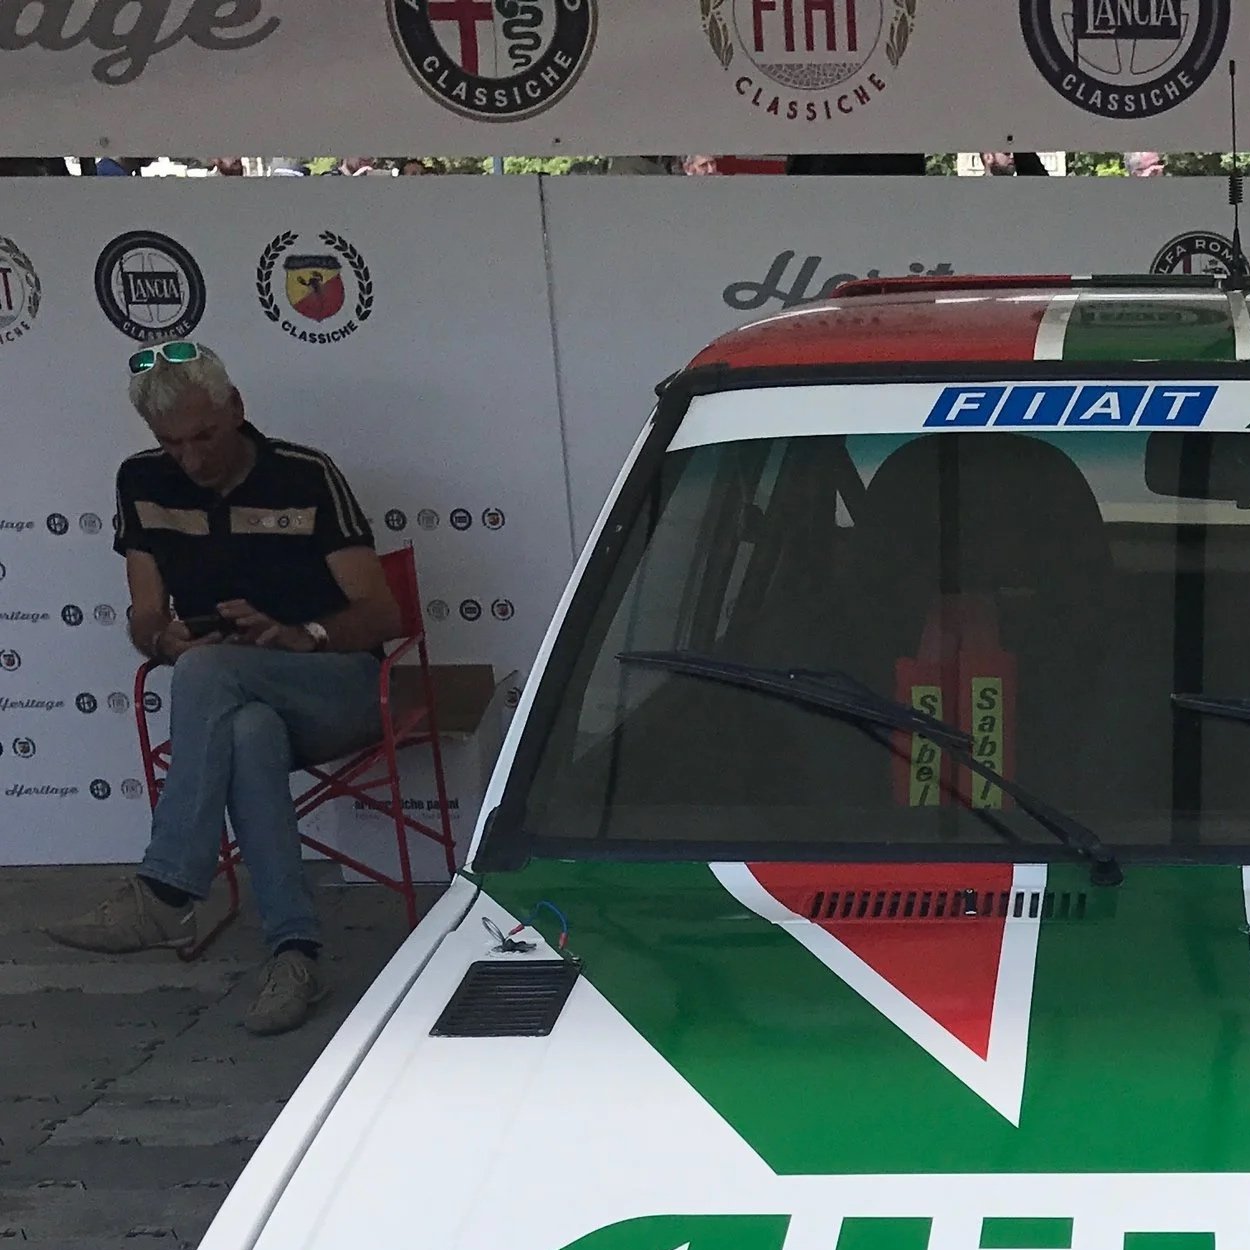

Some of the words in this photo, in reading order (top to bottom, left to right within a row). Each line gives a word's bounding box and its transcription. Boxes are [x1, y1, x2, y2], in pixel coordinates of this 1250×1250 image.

[423, 51, 572, 107] CLASSICHE
[735, 73, 886, 121] CLASSICHE
[1062, 71, 1193, 112] CLASSICHE
[128, 273, 179, 302] LANCIA
[281, 320, 358, 344] CLASSICHE
[943, 390, 1205, 422] FIAT
